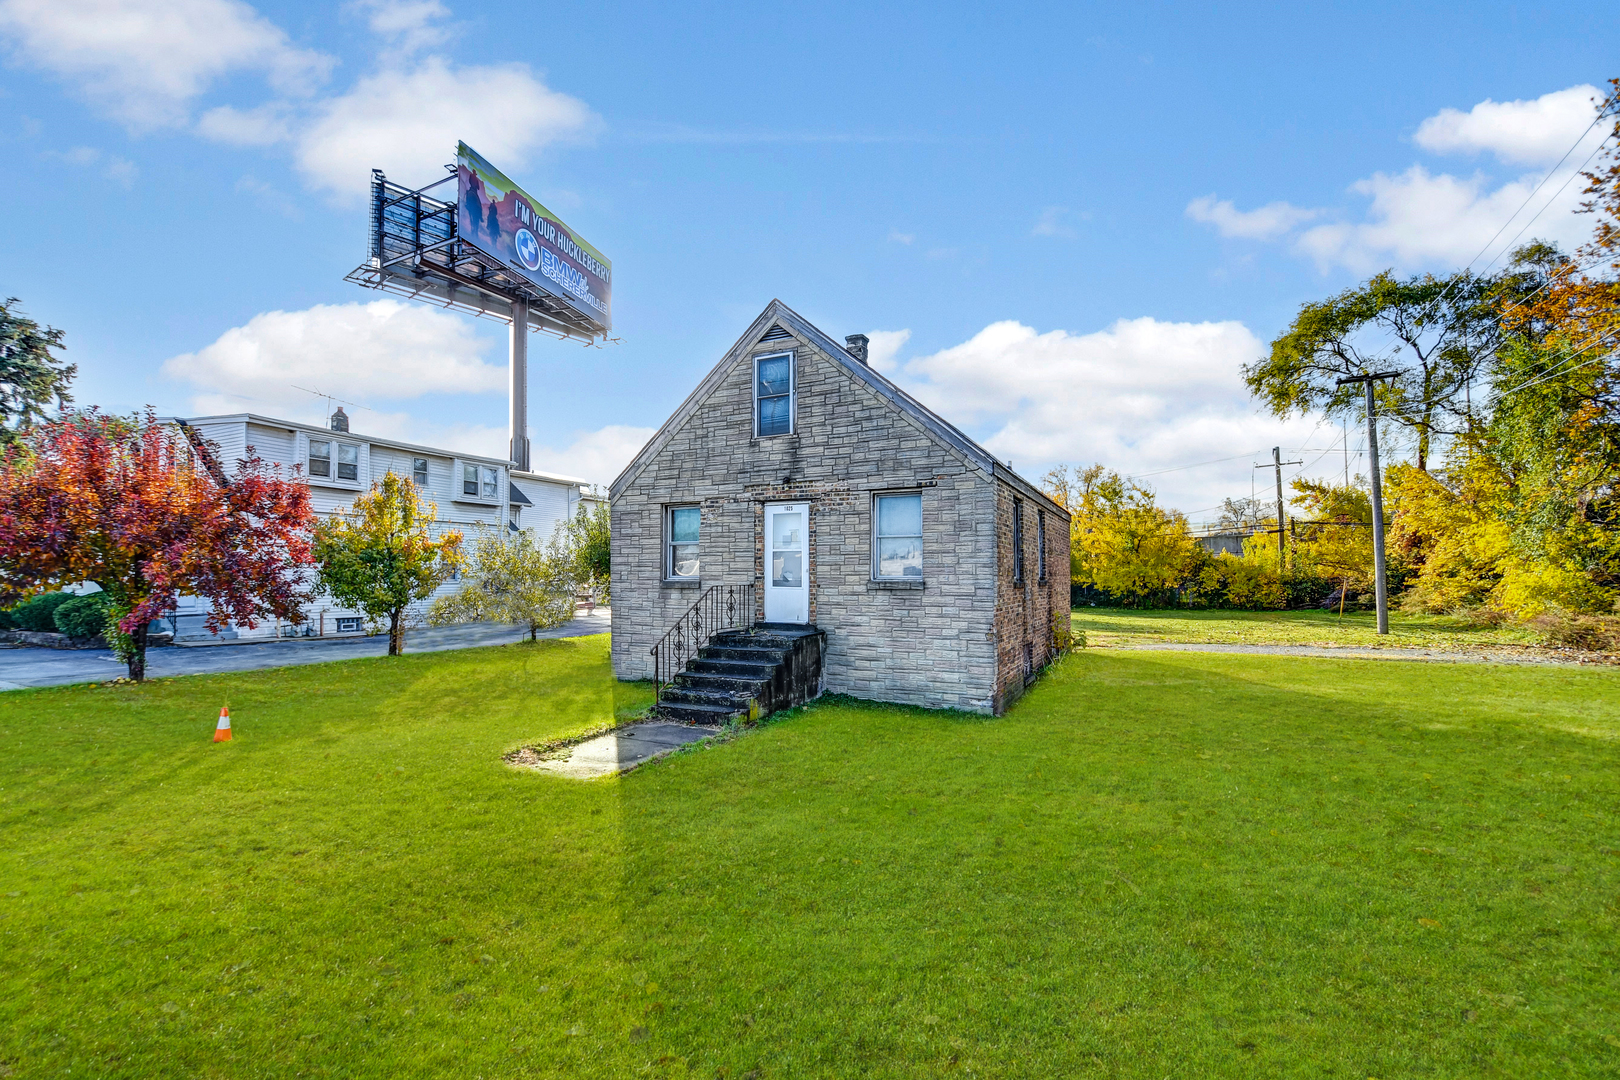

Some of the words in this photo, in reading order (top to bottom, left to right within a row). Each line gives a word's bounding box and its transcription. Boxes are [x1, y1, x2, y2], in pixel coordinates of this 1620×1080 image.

[515, 199, 530, 226] I'M
[532, 212, 556, 245] YOUR
[557, 231, 611, 283] HUCKLEBERRY
[541, 246, 582, 287] BMW
[541, 263, 608, 315] SCHERERVILLE
